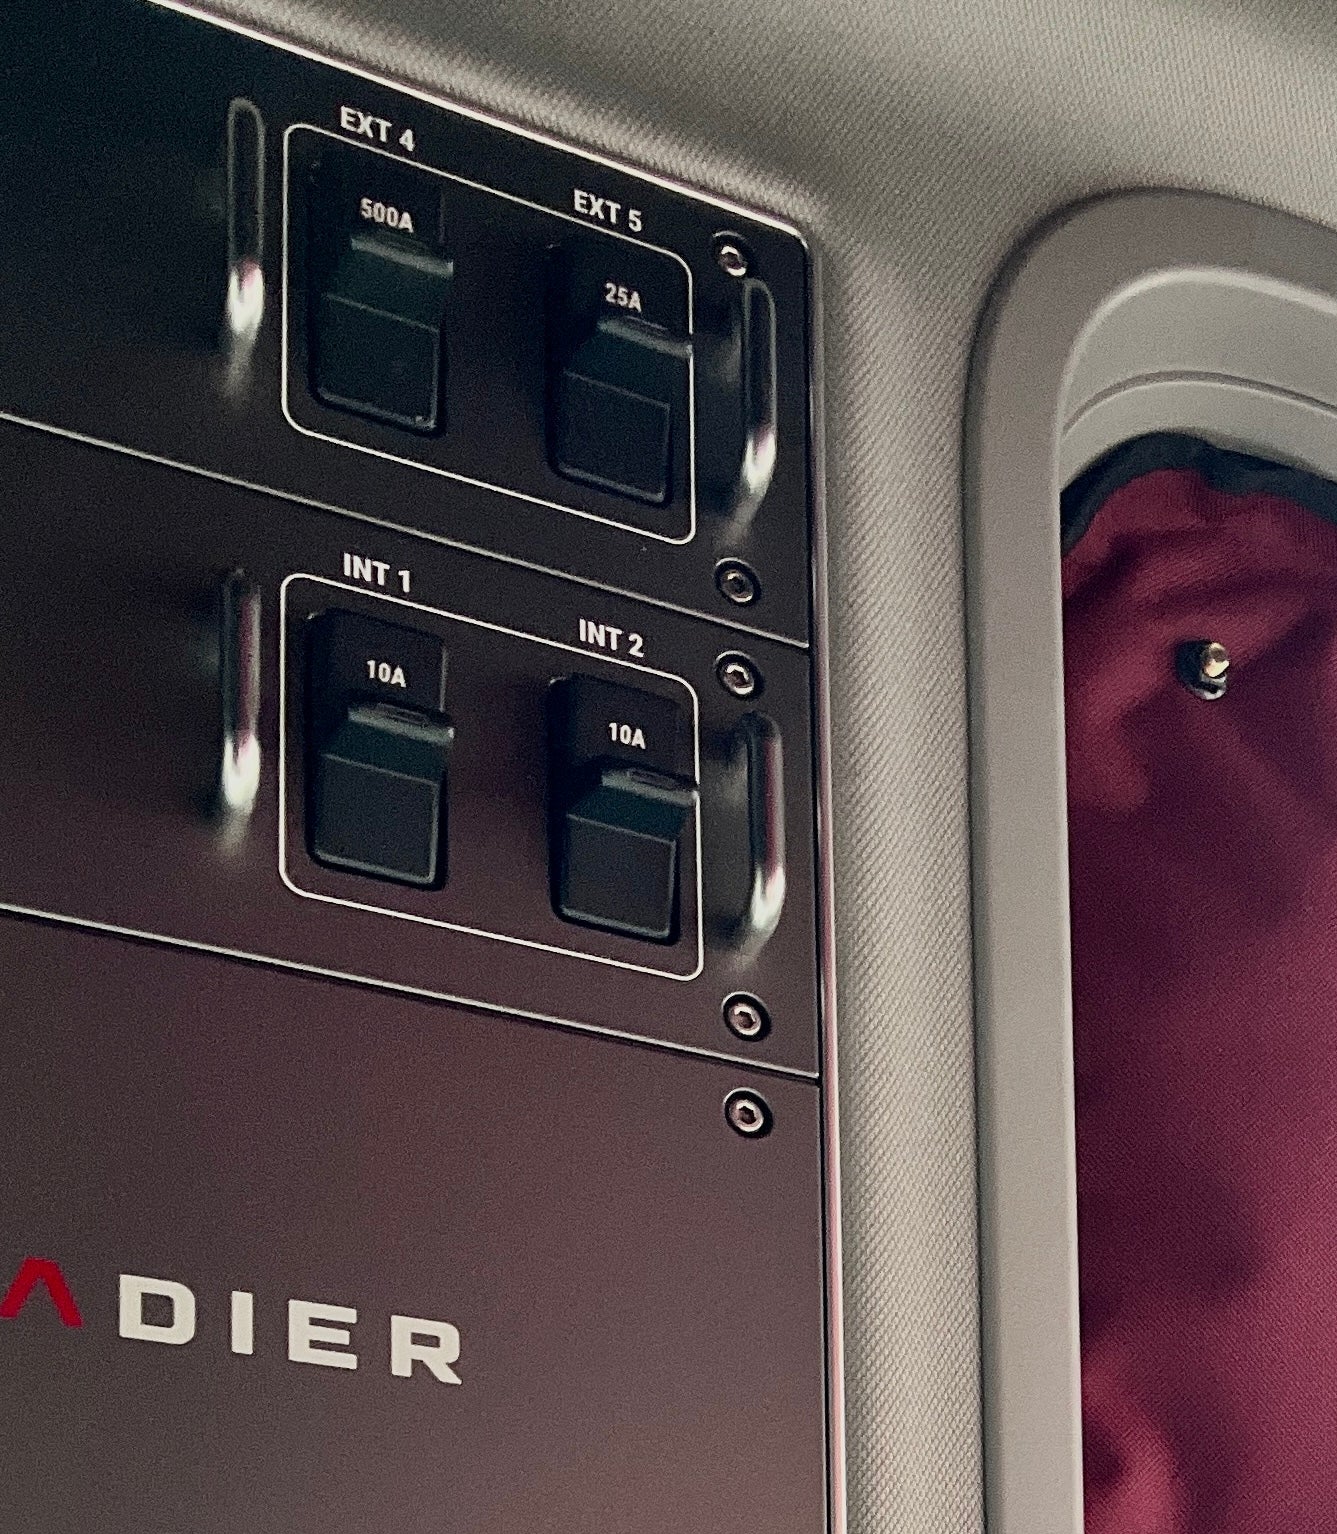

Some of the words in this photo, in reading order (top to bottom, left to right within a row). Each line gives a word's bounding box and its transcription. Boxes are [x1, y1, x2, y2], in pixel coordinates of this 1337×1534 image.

[340, 105, 392, 142] EXT
[399, 128, 415, 152] 4
[360, 197, 414, 233] 500A
[573, 188, 621, 224] EXT
[627, 208, 642, 232] 5
[605, 282, 642, 313] 25A
[343, 552, 390, 586] INT
[397, 569, 411, 593] 1
[578, 618, 623, 651] INT
[627, 633, 645, 658] 2
[366, 659, 407, 688] 10A
[608, 722, 646, 750] 10A
